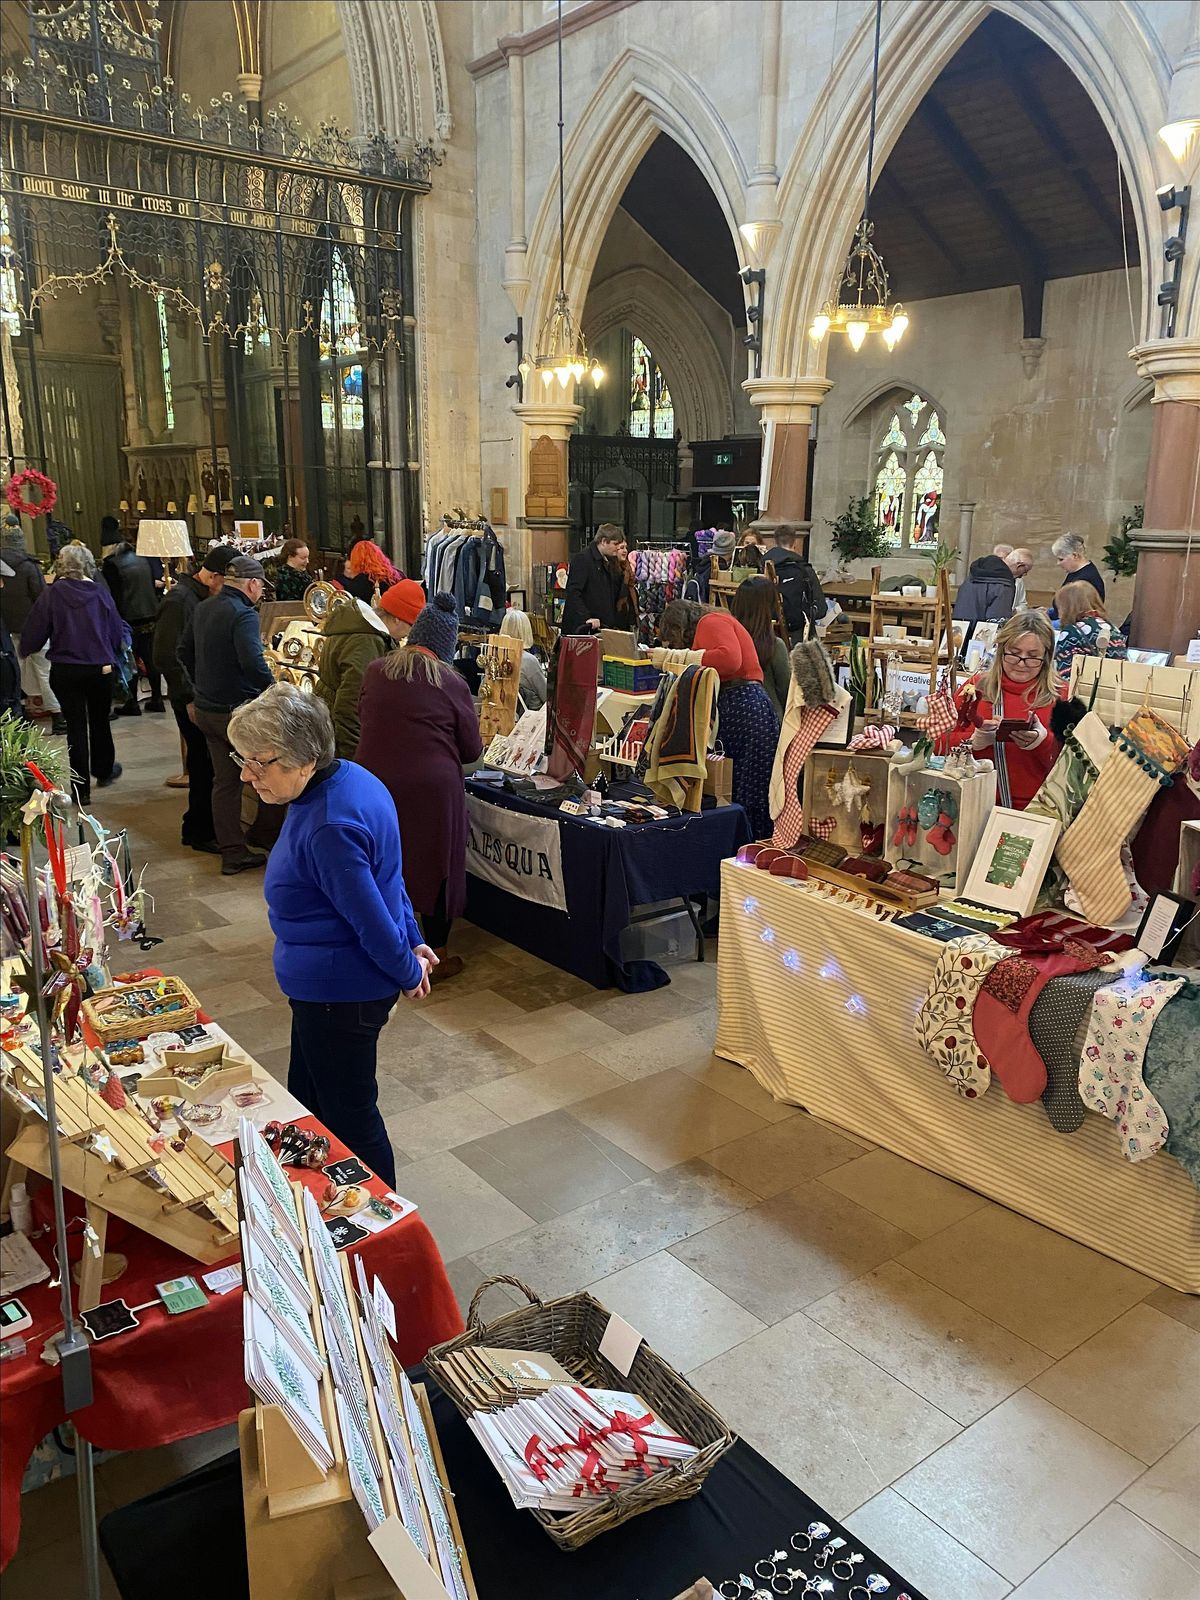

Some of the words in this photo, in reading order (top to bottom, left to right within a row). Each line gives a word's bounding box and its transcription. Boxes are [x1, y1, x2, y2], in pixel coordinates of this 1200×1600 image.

[61, 183, 90, 200] save
[98, 189, 111, 204] in
[116, 190, 135, 207] the
[142, 196, 172, 213] cross
[178, 202, 191, 216] of
[230, 210, 248, 225] our
[901, 674, 931, 686] creative
